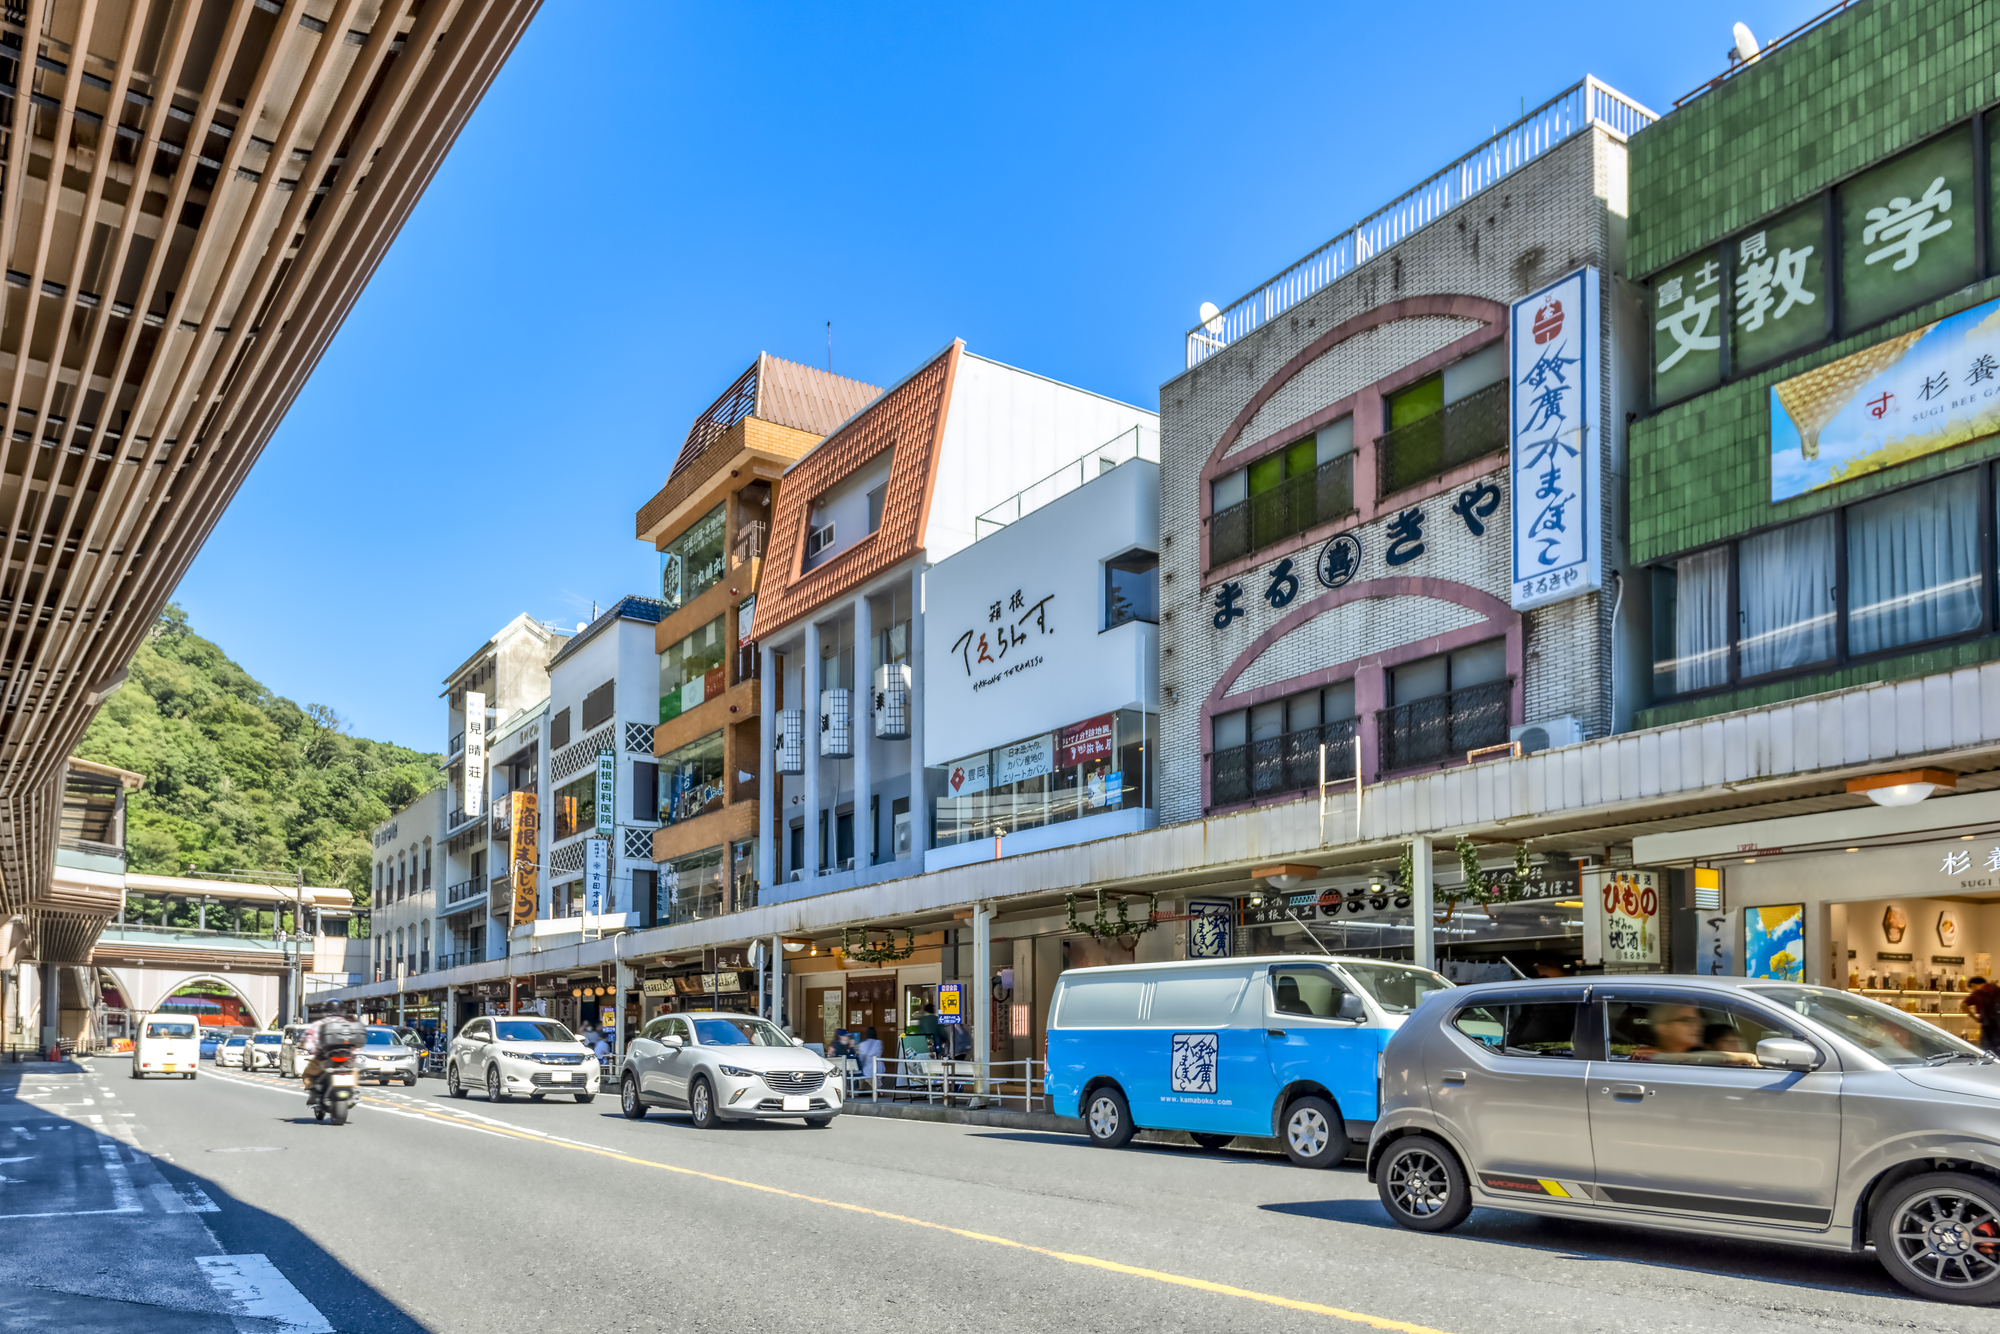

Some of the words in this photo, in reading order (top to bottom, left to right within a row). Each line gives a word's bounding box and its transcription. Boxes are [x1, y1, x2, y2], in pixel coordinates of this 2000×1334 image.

[1912, 405, 1945, 422] SUGI
[1951, 394, 1977, 409] BEE
[1522, 567, 1578, 599] まるきや
[989, 589, 1025, 623] 箱根
[973, 672, 1002, 692] HAKONE
[468, 721, 482, 778] 見晴荘
[1007, 752, 1044, 770] カバン産地の
[600, 759, 612, 825] 箱根歯科医院
[1610, 871, 1651, 885] 産地直送
[1960, 878, 1992, 888] SUGI
[1602, 883, 1657, 916] ひもの
[1608, 931, 1638, 951] 地酒
[1191, 1036, 1218, 1092] 鈴廣
[1160, 1096, 1233, 1106] www.kamaboko.com
[1487, 1179, 1542, 1191] WORKS
